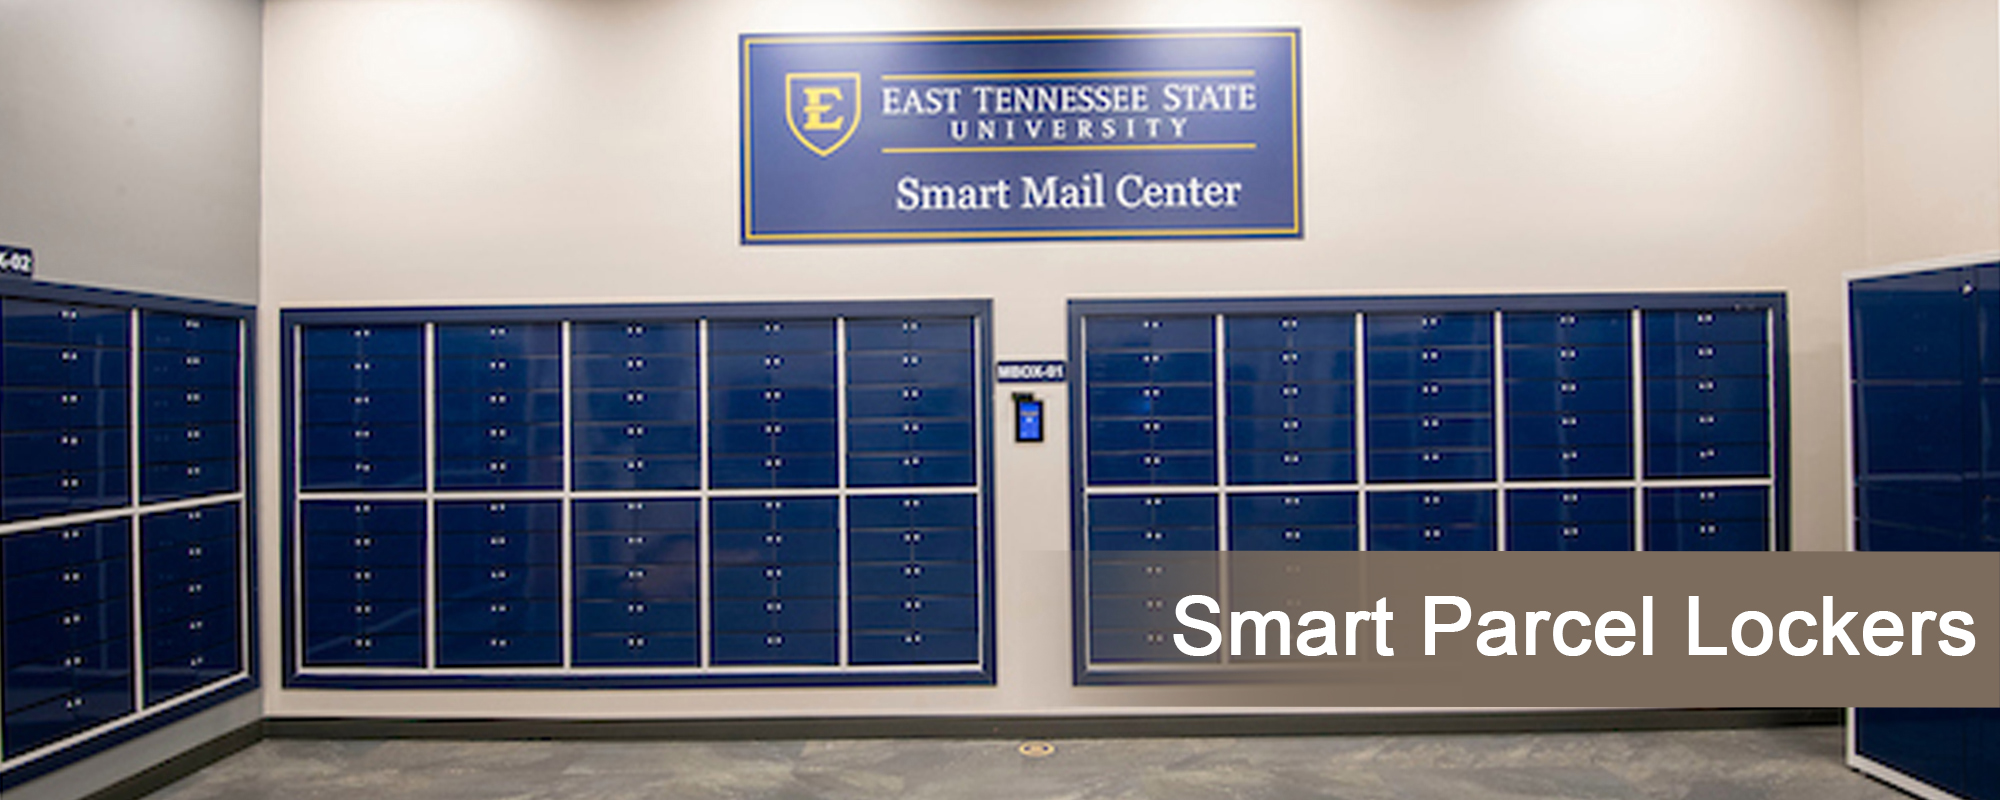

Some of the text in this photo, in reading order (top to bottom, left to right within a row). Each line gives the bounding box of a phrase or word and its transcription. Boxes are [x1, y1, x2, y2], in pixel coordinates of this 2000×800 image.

[881, 83, 1257, 115] EAST TENNESSEE STATE
[950, 117, 1189, 141] UNIVERSITY
[896, 172, 1242, 211] Smart Mail Center
[998, 364, 1064, 379] MBOX-01
